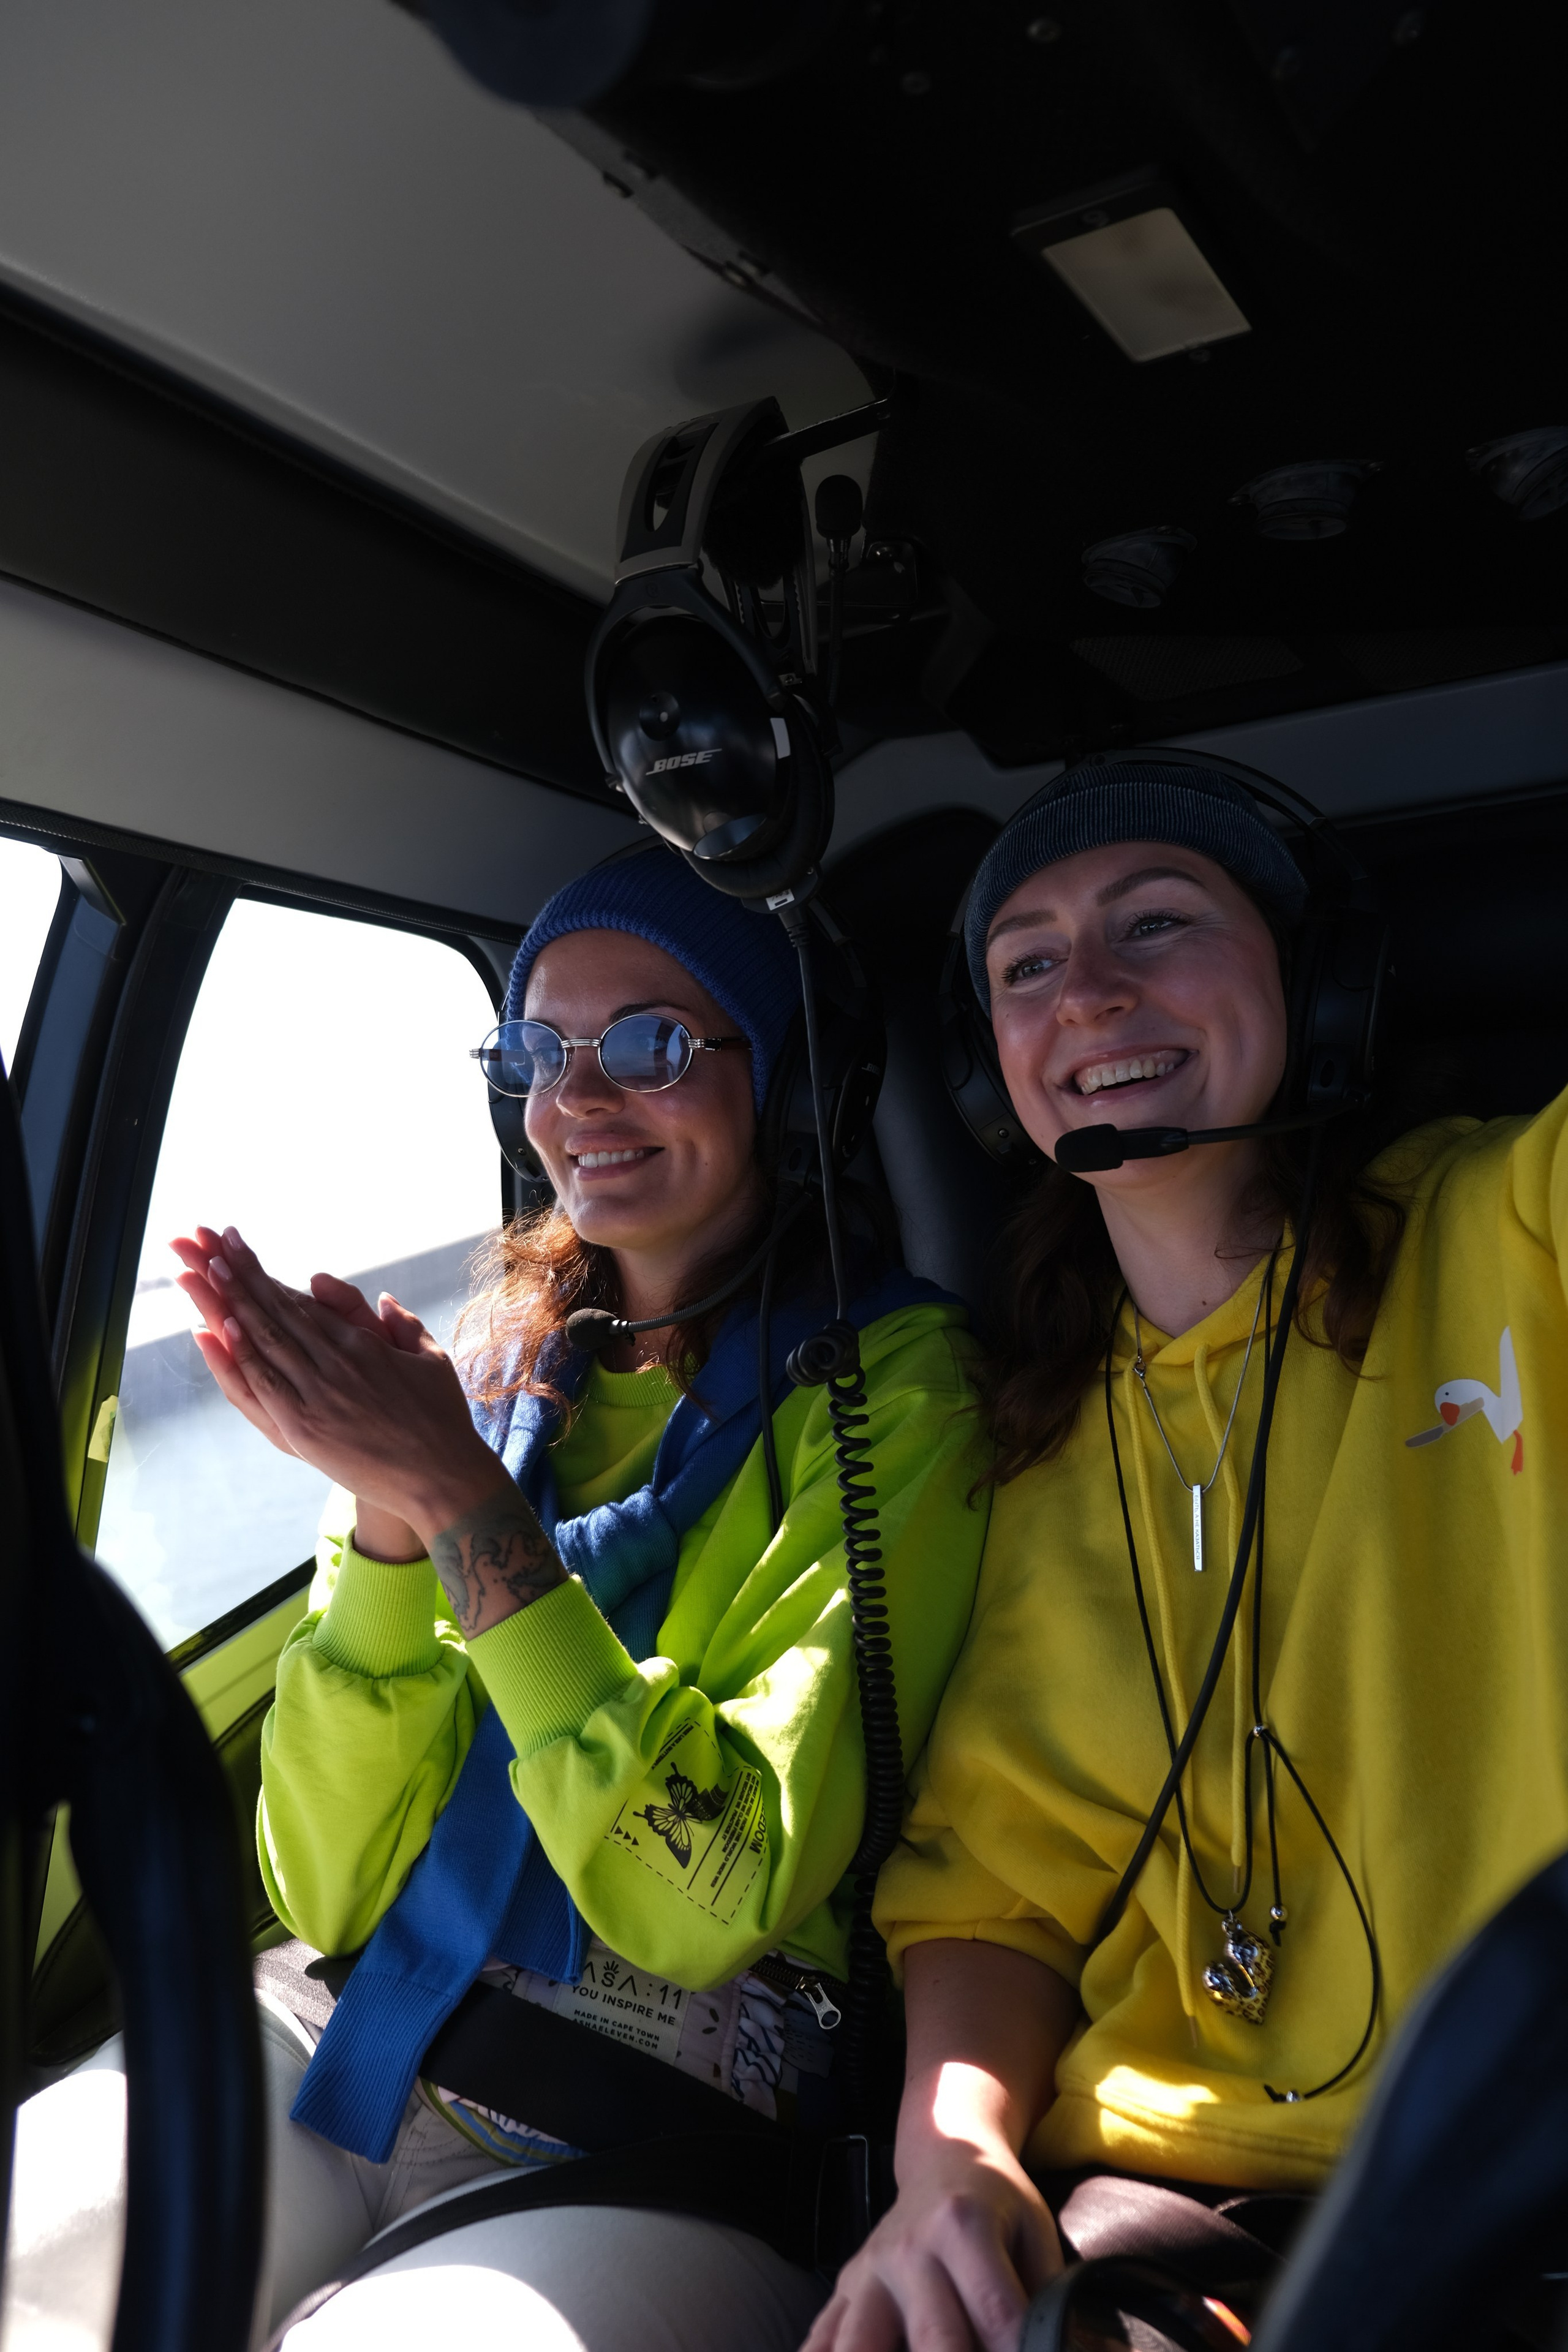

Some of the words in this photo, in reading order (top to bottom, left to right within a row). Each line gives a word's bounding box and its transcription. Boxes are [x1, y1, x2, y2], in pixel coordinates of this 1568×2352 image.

[646, 748, 722, 775] BOSE
[725, 1809, 738, 1834] PRACTICE
[722, 1826, 737, 1852] FREEDOM
[725, 1842, 737, 1861] WORLD
[717, 1862, 726, 1875] WIDE
[710, 1875, 720, 1888] WEB
[572, 1985, 598, 1999] YOU
[603, 1994, 654, 2018] INSPIRE
[657, 2012, 676, 2026] ME
[574, 2010, 597, 2021] MADE
[612, 2021, 633, 2032] CAPE
[636, 2029, 660, 2041] TOWN
